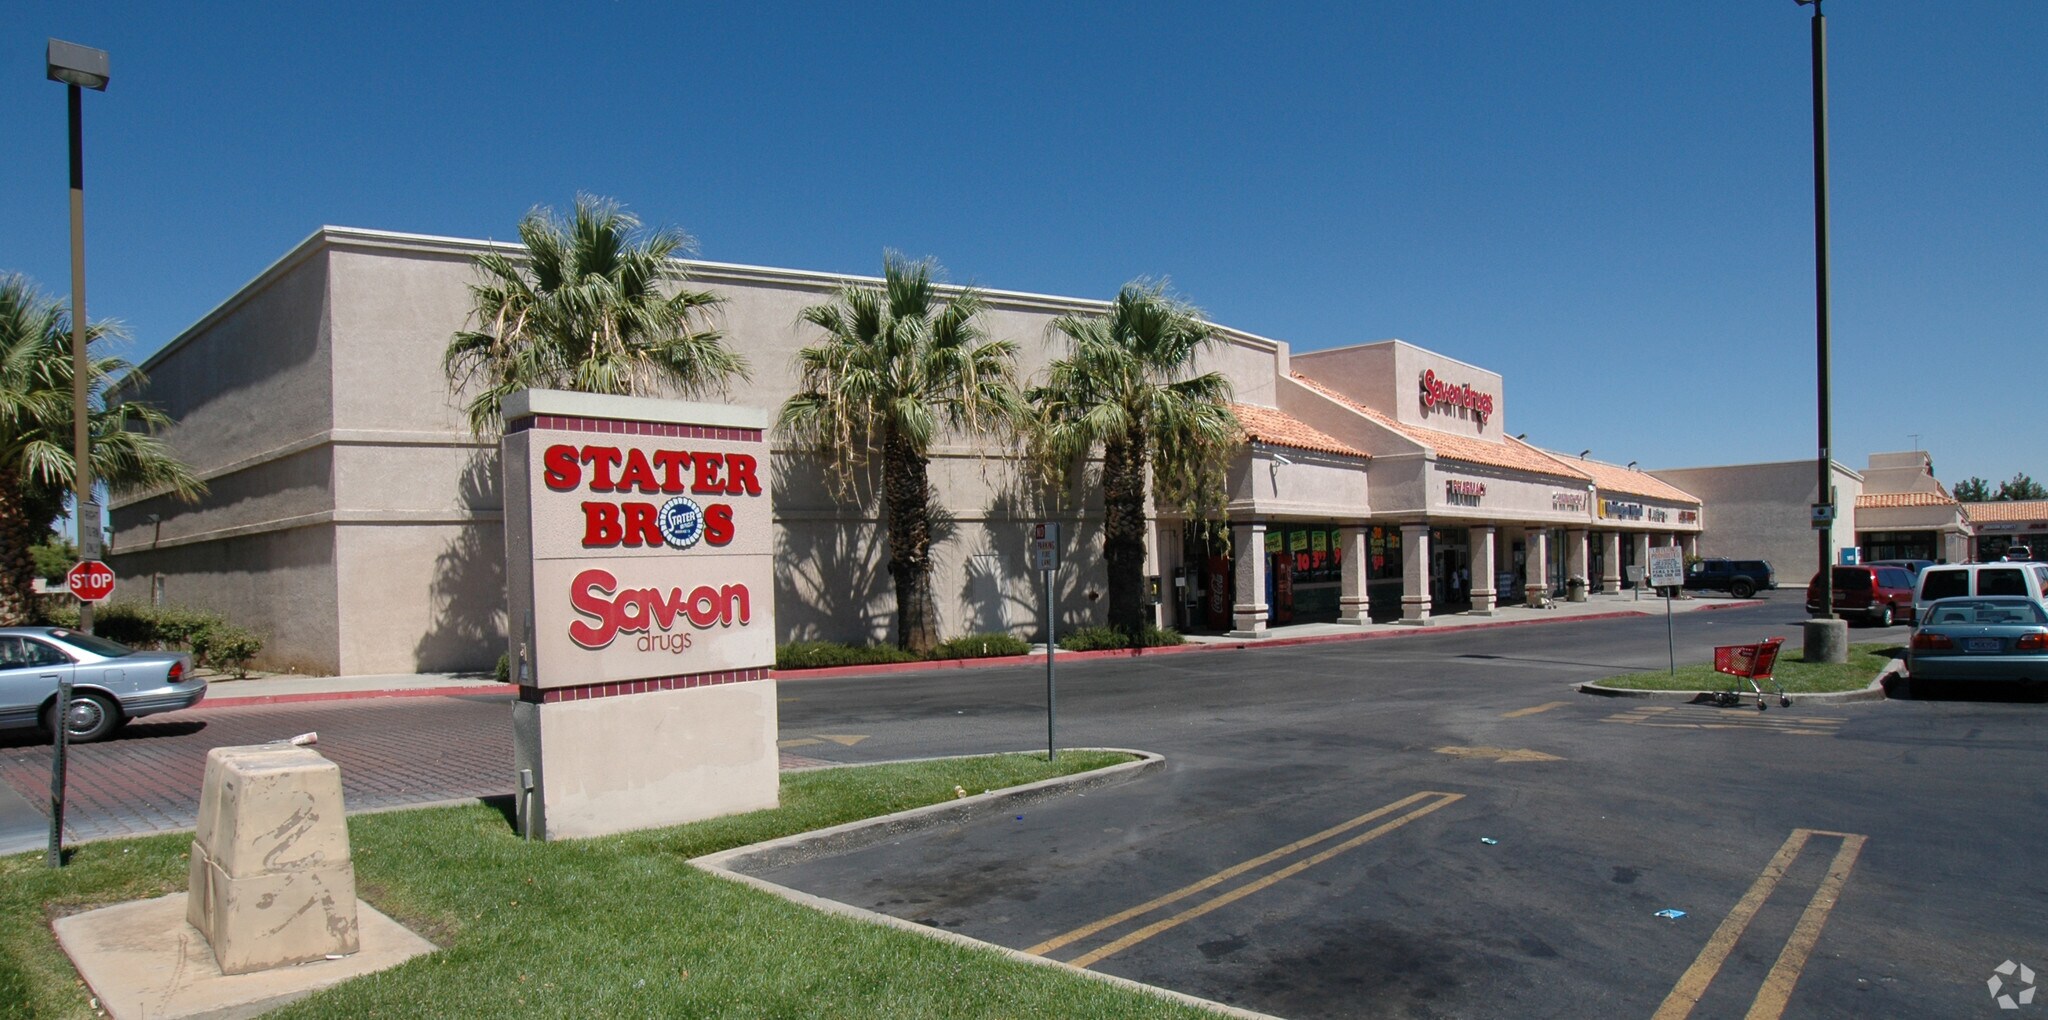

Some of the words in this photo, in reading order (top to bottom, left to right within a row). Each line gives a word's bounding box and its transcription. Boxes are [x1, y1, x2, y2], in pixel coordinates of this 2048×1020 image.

[1463, 383, 1493, 424] drugs
[543, 444, 762, 496] STATER
[668, 509, 695, 532] STATER
[71, 573, 112, 589] STOP
[569, 568, 751, 649] Sav-on
[636, 631, 692, 655] drugs
